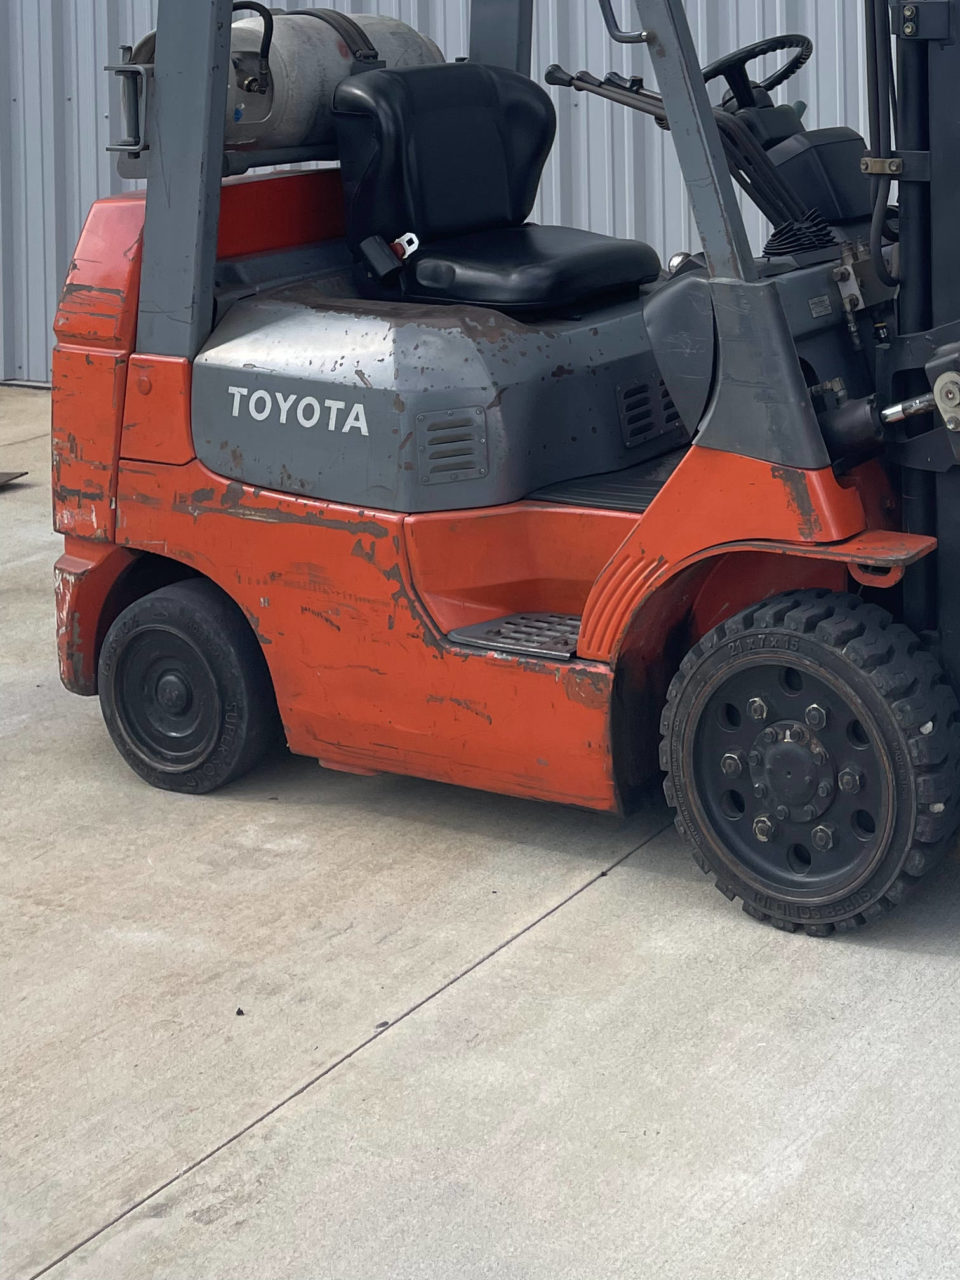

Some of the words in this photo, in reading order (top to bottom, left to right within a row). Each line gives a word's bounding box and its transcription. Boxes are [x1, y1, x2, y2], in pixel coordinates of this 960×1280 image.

[228, 386, 369, 436] TOYOTA
[727, 639, 743, 657] 21
[757, 634, 766, 649] 7
[783, 635, 799, 651] 15
